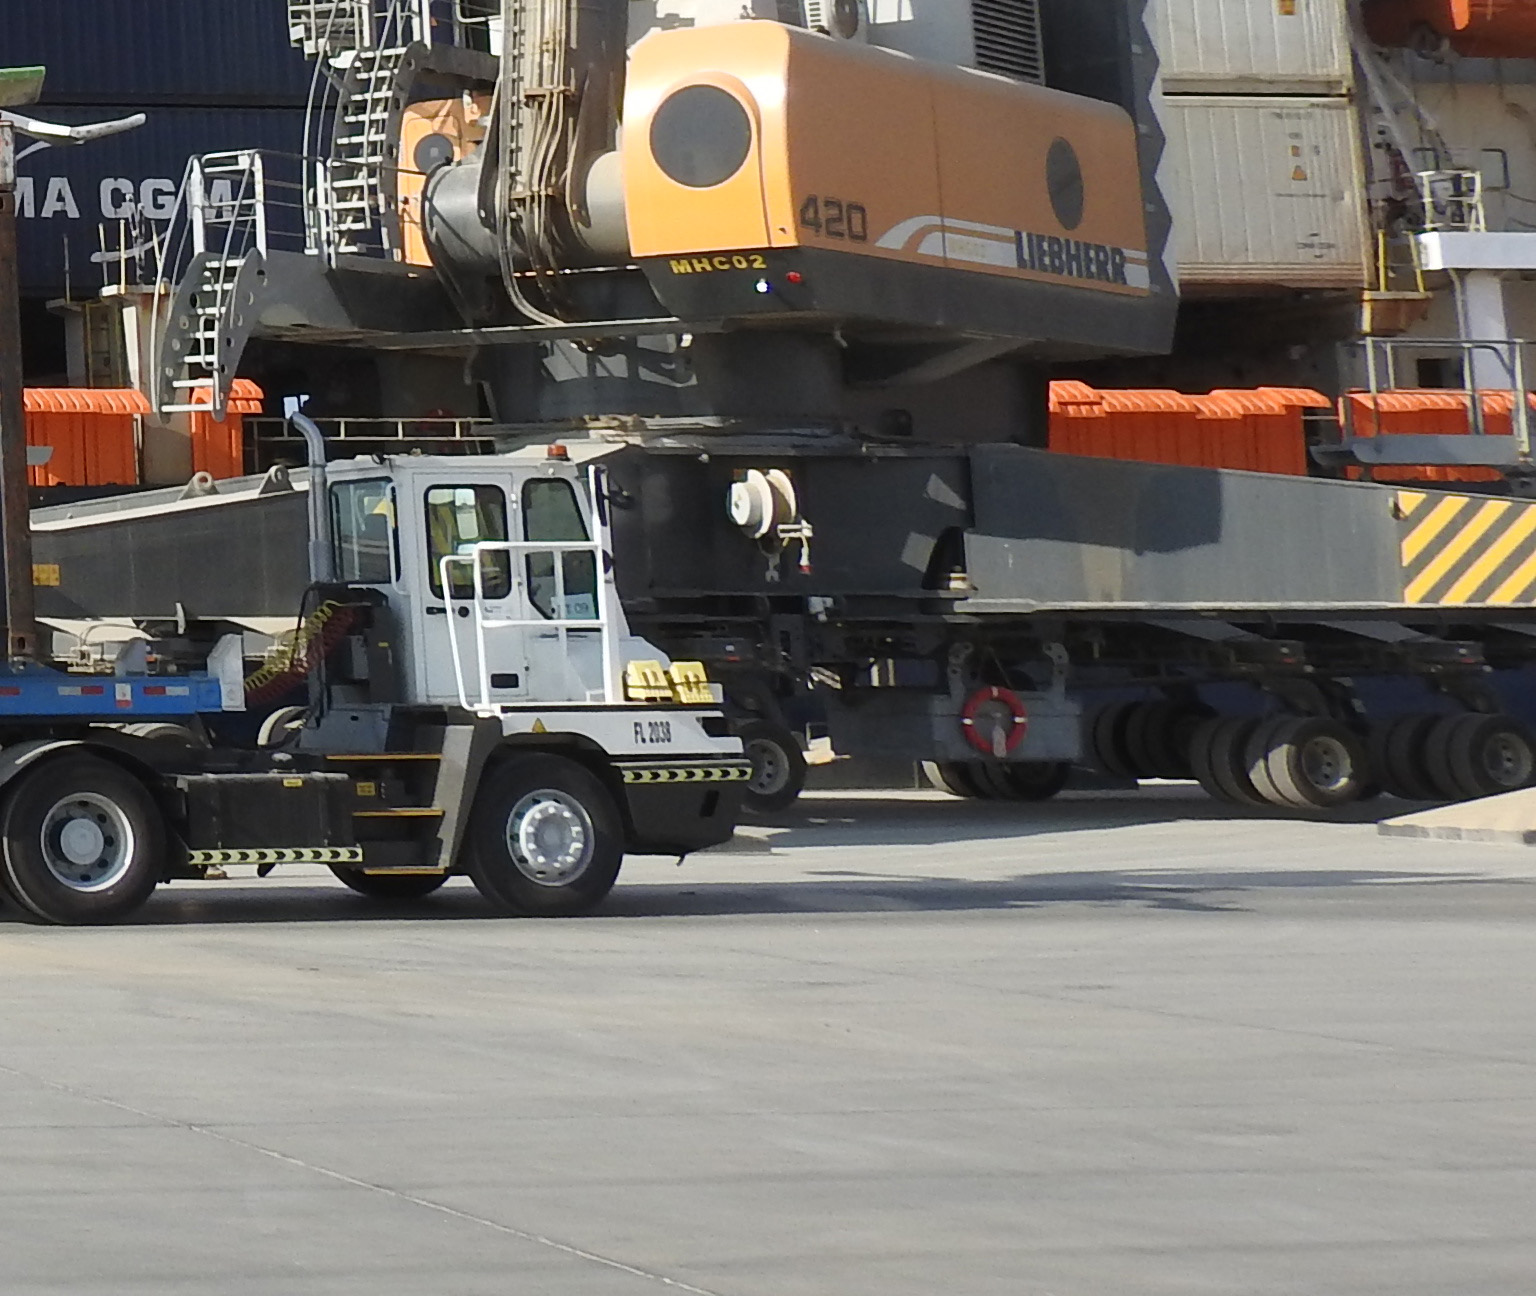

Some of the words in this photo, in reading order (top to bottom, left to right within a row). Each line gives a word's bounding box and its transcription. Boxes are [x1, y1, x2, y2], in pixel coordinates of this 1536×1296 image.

[800, 194, 868, 241] 420
[669, 254, 768, 274] MHC02
[1014, 230, 1127, 285] LIEBHERR
